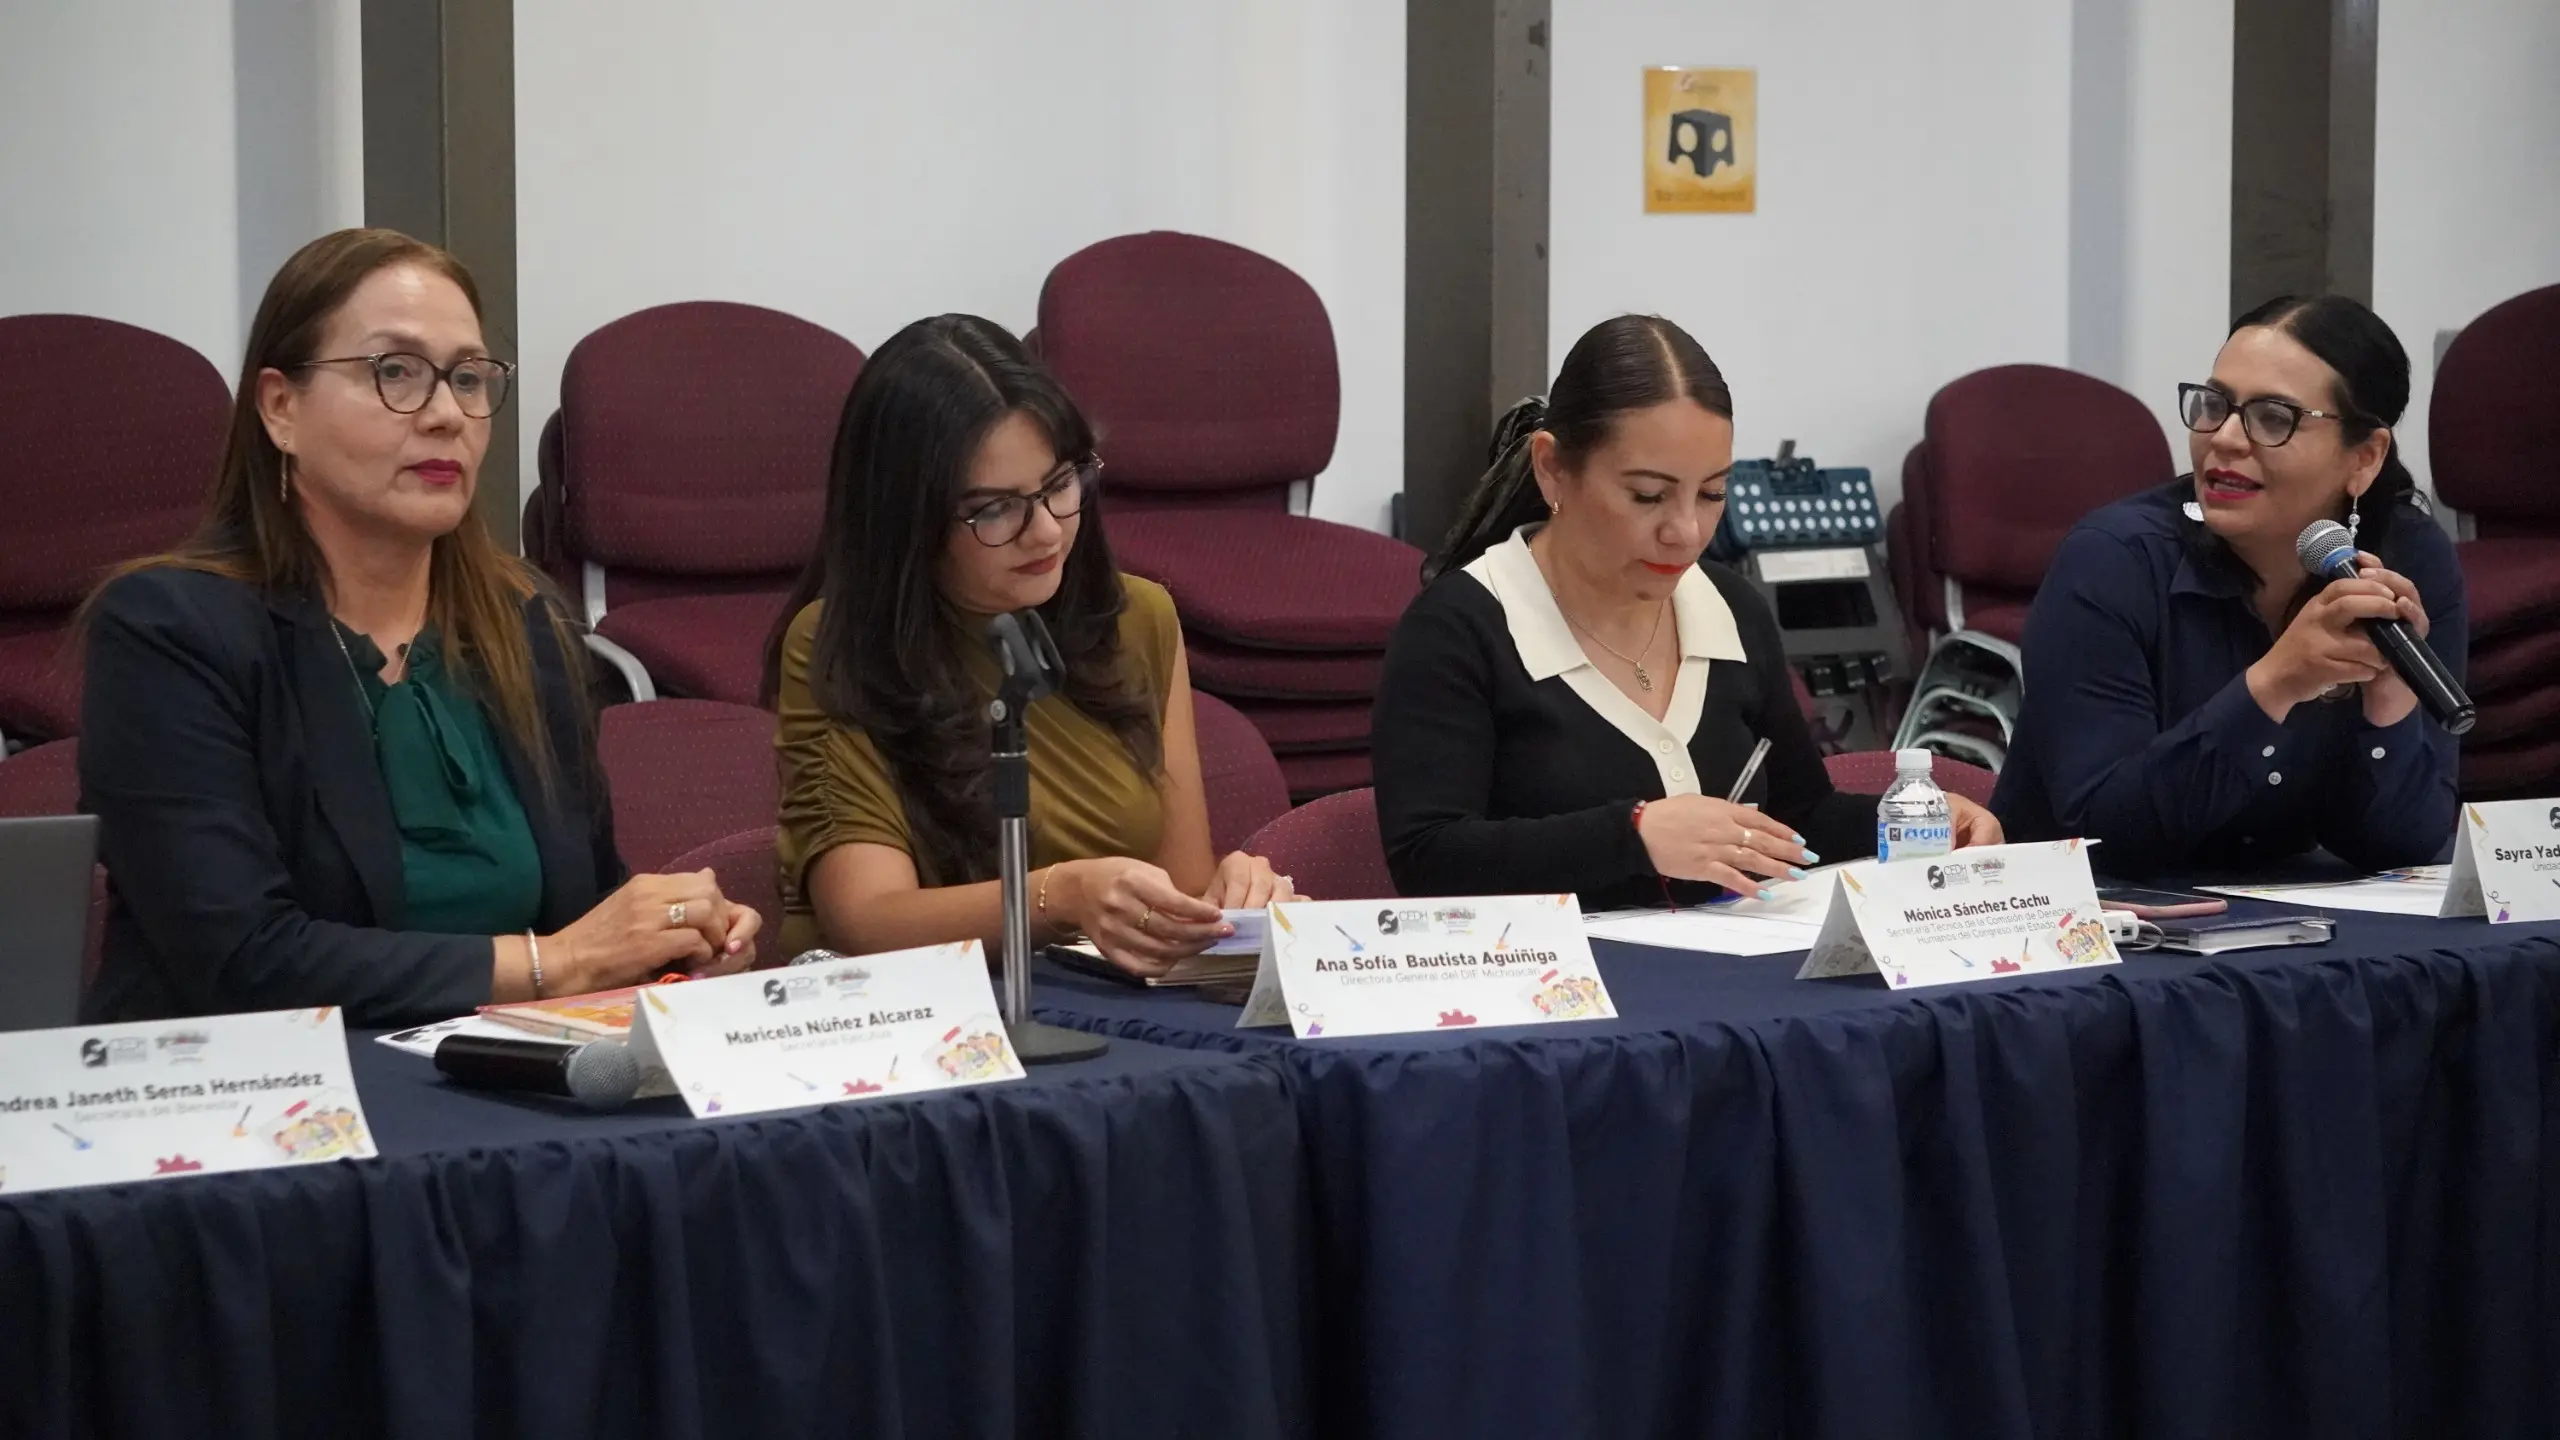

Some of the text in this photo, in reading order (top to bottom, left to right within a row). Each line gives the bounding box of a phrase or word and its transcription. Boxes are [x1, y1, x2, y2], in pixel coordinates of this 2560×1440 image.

[2495, 848, 2533, 862] Sayra
[1904, 894, 2050, 923] Mónica Sánchez Cachu
[1964, 917, 1976, 928] de
[2025, 910, 2036, 921] de
[2038, 906, 2077, 919] Derechos
[1917, 919, 2056, 944] Humanos del Congreso del Estado
[1316, 948, 1557, 972] Ana Sofía Bautista Aguiñiga
[1341, 975, 1392, 986] Directora
[1395, 971, 1438, 983] General
[1441, 969, 1457, 981] del
[1461, 968, 1477, 979] DIF
[725, 1006, 934, 1045] Maricela Núñez Alcaraz
[67, 1087, 137, 1107] Janeth
[144, 1083, 204, 1100] Serna
[210, 1072, 325, 1095] Hernández
